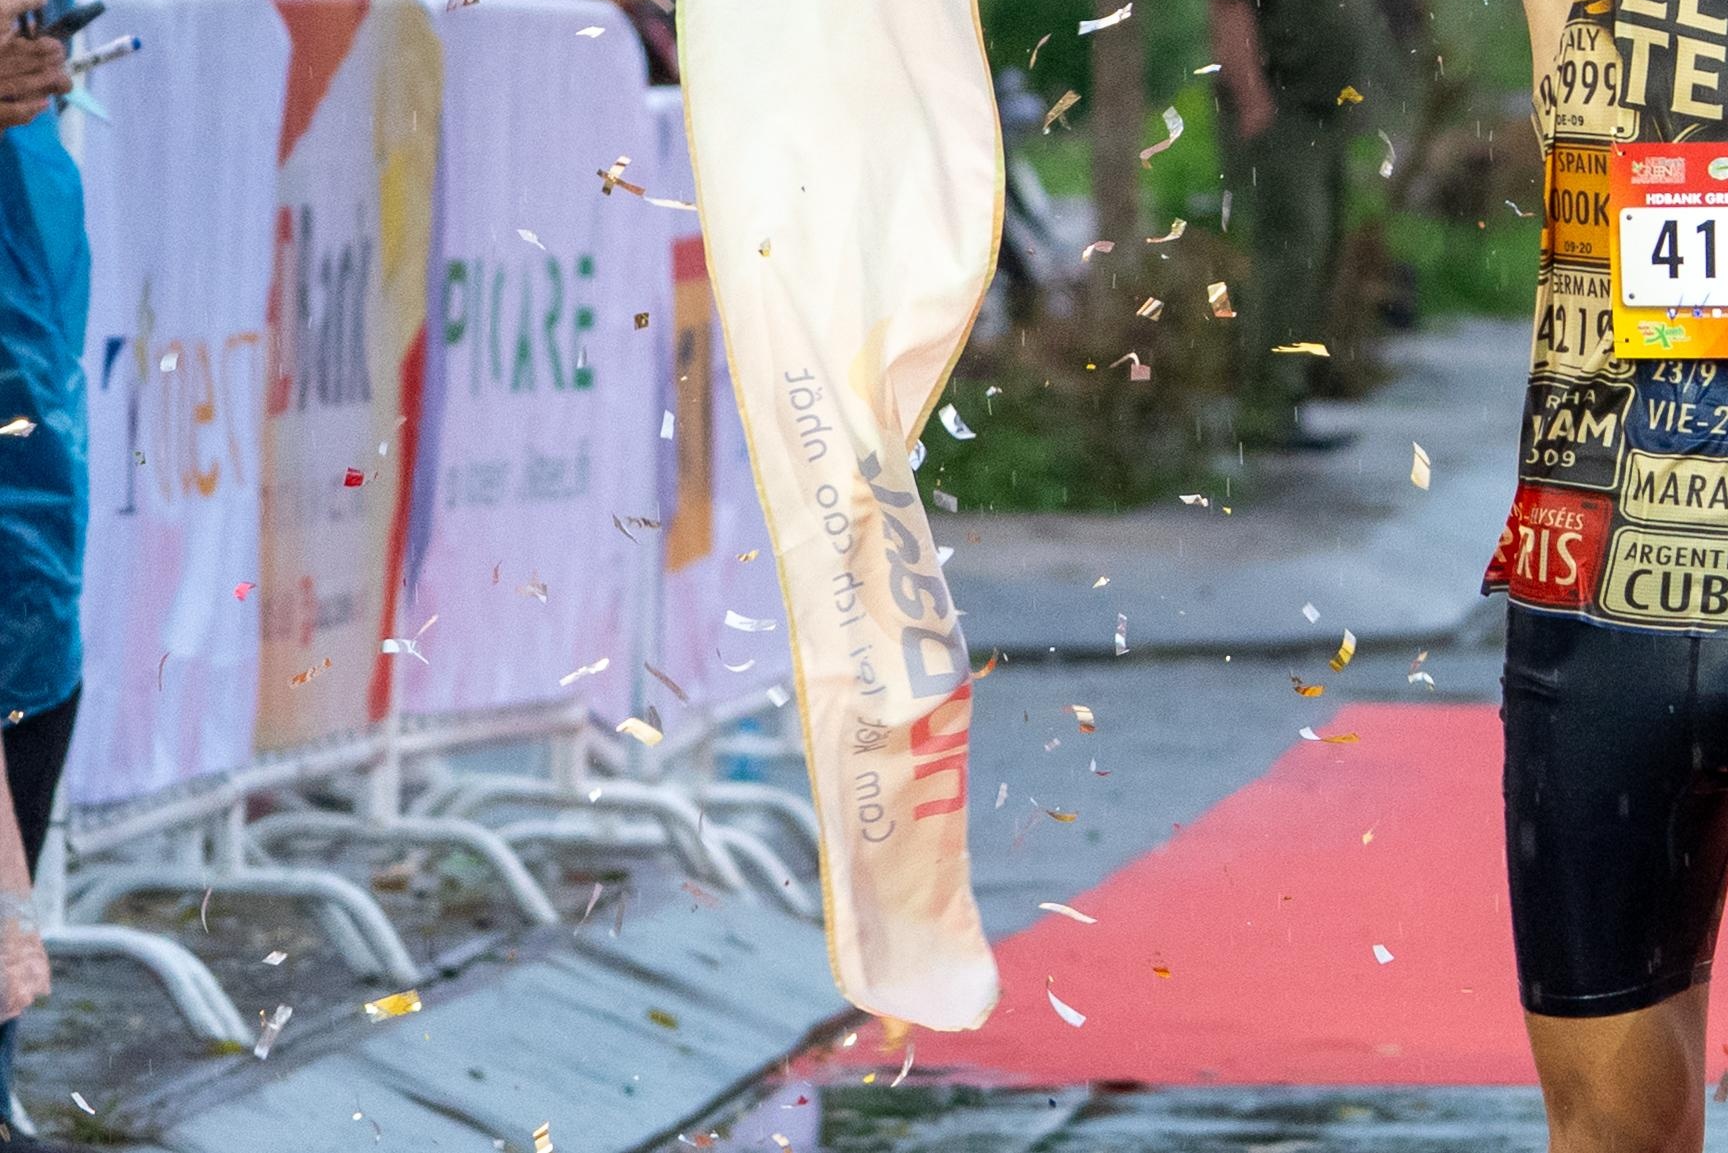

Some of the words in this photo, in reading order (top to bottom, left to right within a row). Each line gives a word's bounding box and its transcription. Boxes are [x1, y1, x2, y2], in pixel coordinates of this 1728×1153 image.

[1562, 27, 1601, 52] ALY
[1557, 150, 1608, 176] SPAIN
[1646, 192, 1702, 205] HDBANK
[1552, 273, 1612, 299] GERMAN
